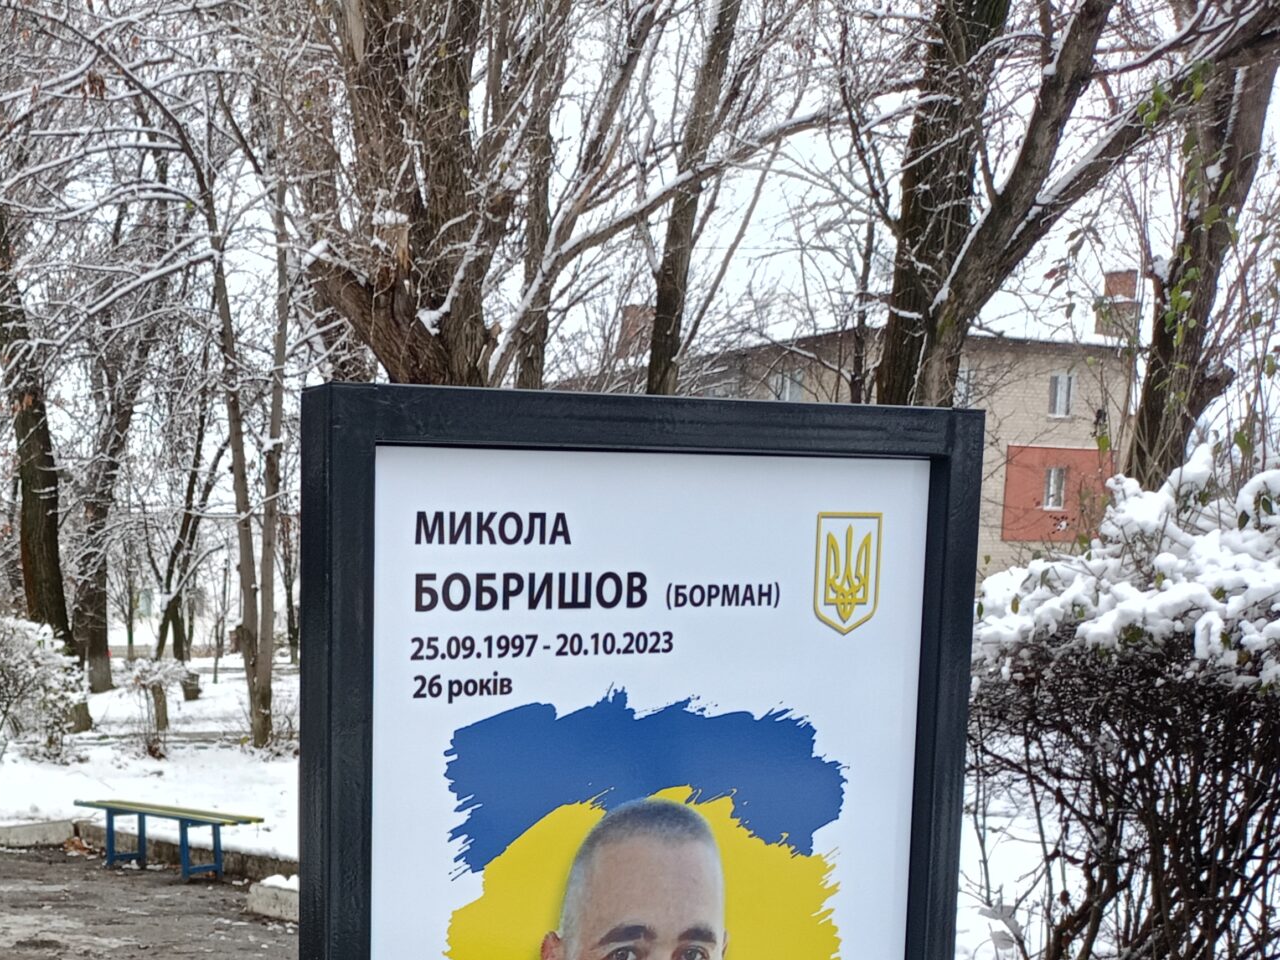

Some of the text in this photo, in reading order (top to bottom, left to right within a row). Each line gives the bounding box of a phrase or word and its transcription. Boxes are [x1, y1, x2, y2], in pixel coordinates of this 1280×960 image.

[414, 511, 572, 546] МИКОЛА
[414, 571, 781, 612] БОБРИШОВ (БОРМАН)
[409, 634, 538, 661] 25.09.1997
[555, 631, 674, 656] 20.10.2023
[412, 671, 513, 704] 26 років
